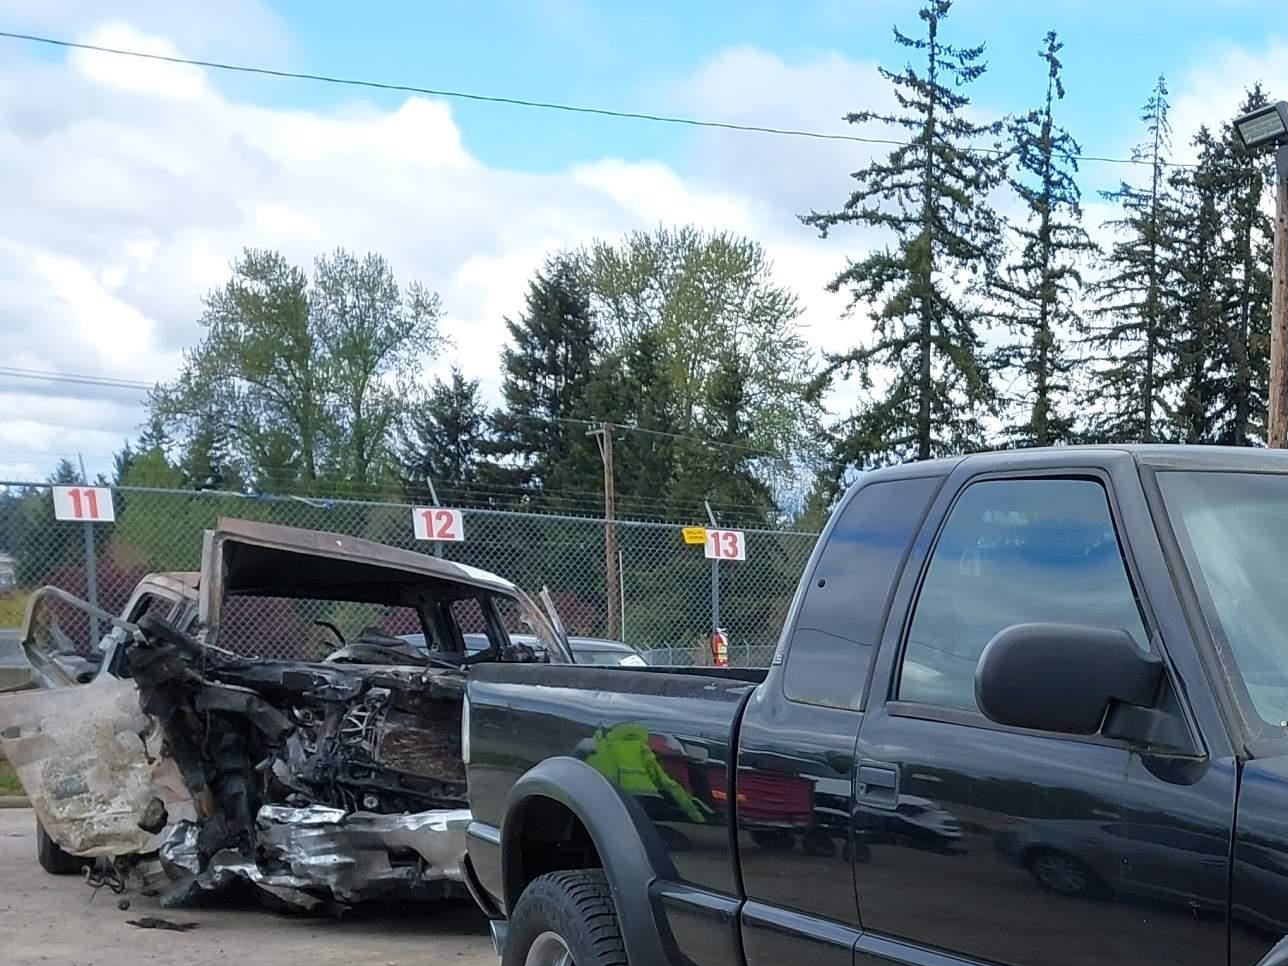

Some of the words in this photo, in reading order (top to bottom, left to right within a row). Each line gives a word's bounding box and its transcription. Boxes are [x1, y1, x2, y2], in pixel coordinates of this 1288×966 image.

[68, 488, 99, 518] 11
[421, 510, 456, 538] 12
[711, 532, 739, 558] 13
